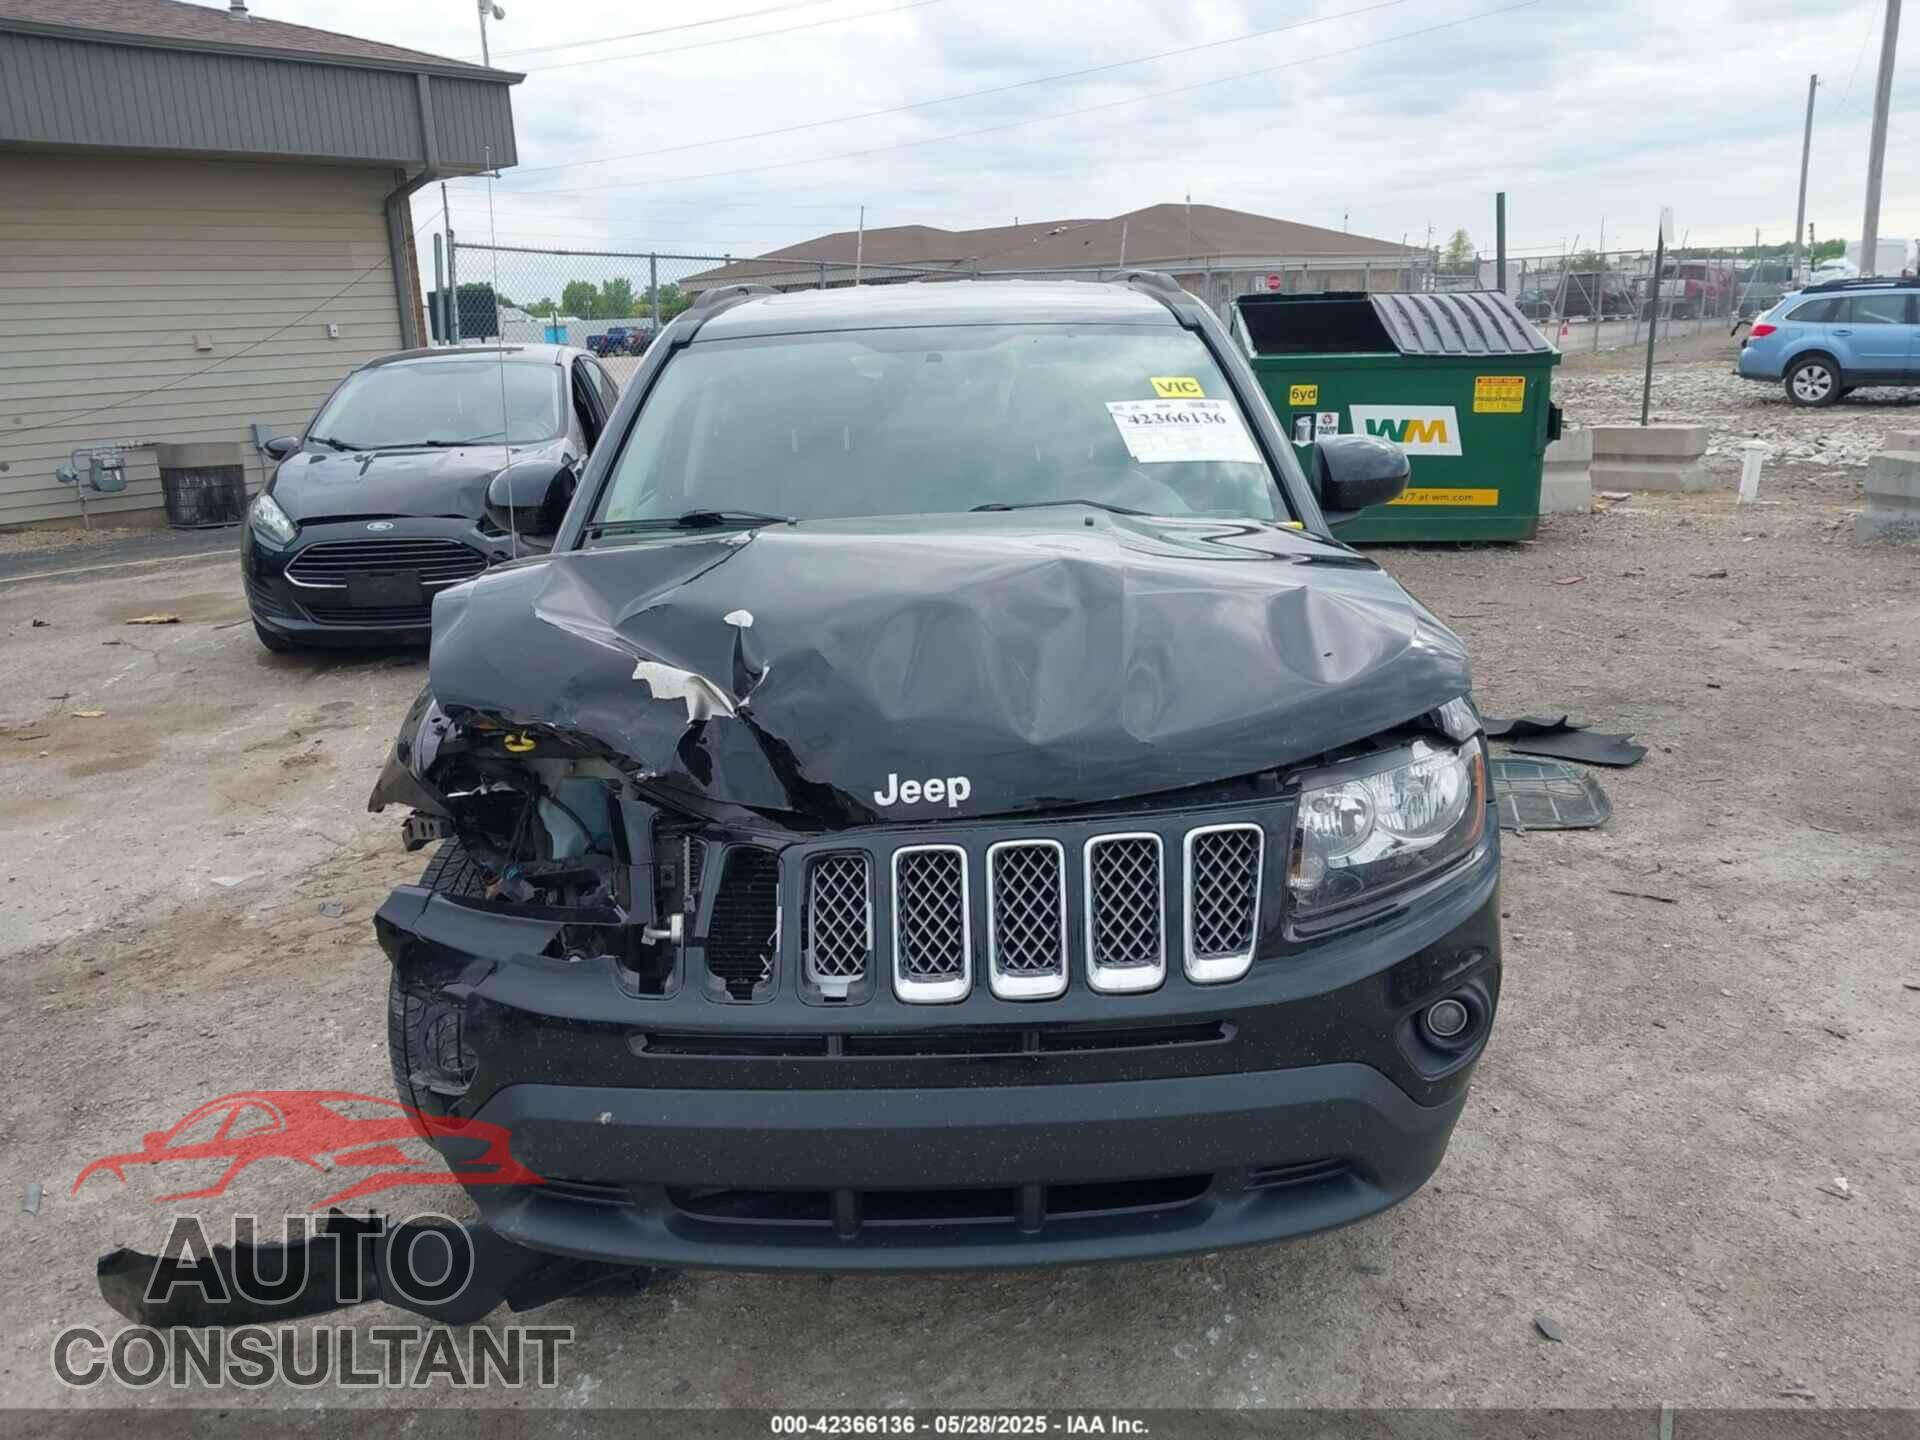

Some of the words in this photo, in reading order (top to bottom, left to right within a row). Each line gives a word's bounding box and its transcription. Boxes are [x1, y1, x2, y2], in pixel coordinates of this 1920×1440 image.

[1157, 381, 1199, 394] VIC
[1292, 387, 1316, 402] 6yd
[1127, 412, 1227, 425] 42366136
[1365, 419, 1448, 443] WM
[874, 773, 971, 808] Jeep
